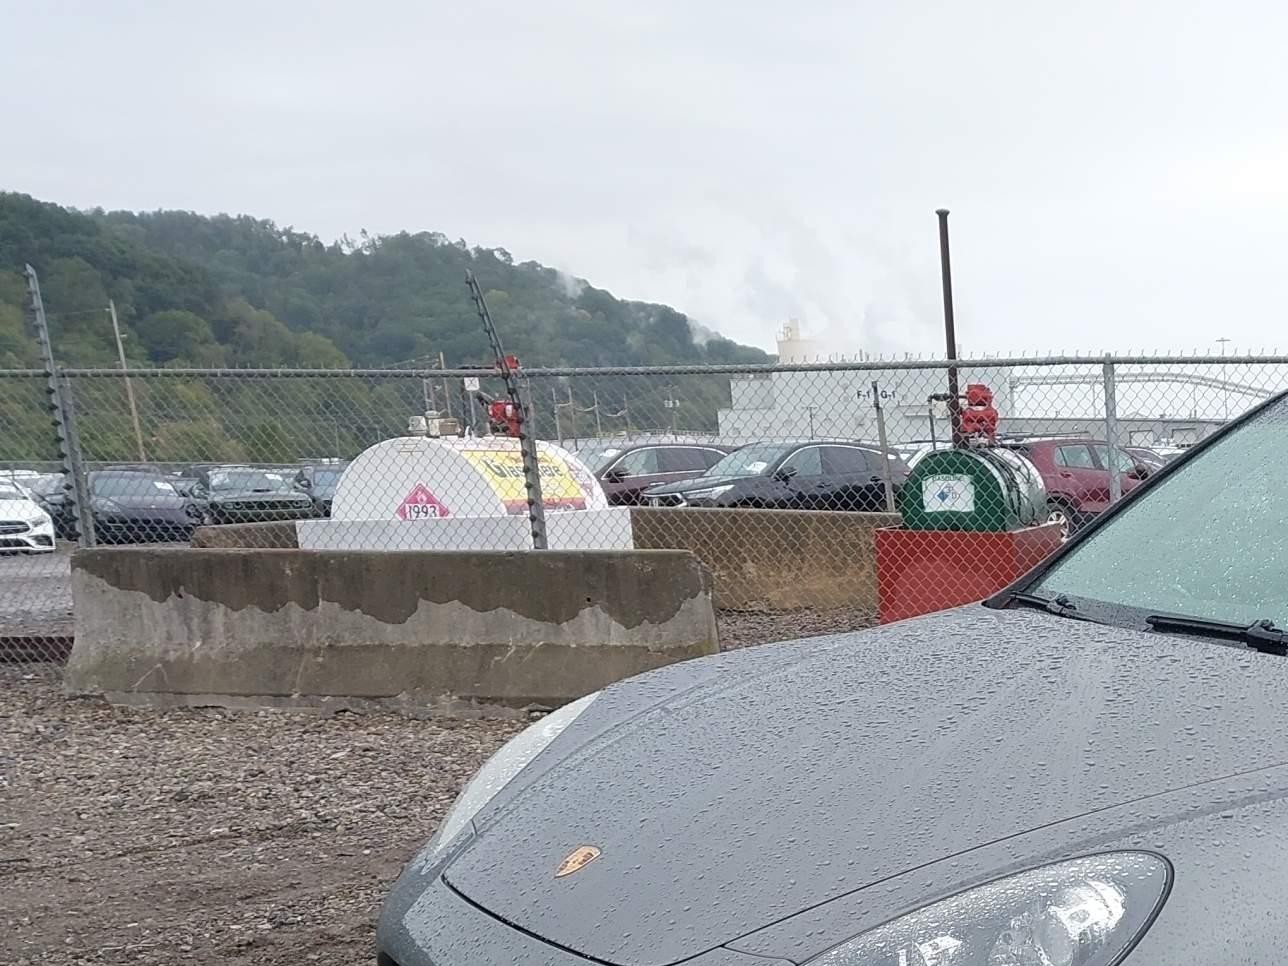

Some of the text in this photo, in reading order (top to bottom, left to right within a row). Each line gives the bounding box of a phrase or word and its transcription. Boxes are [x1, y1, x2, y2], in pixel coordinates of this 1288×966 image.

[857, 390, 870, 399] F-1
[880, 390, 895, 399] G-1
[482, 458, 563, 478] Glasere
[408, 504, 437, 519] 1993
